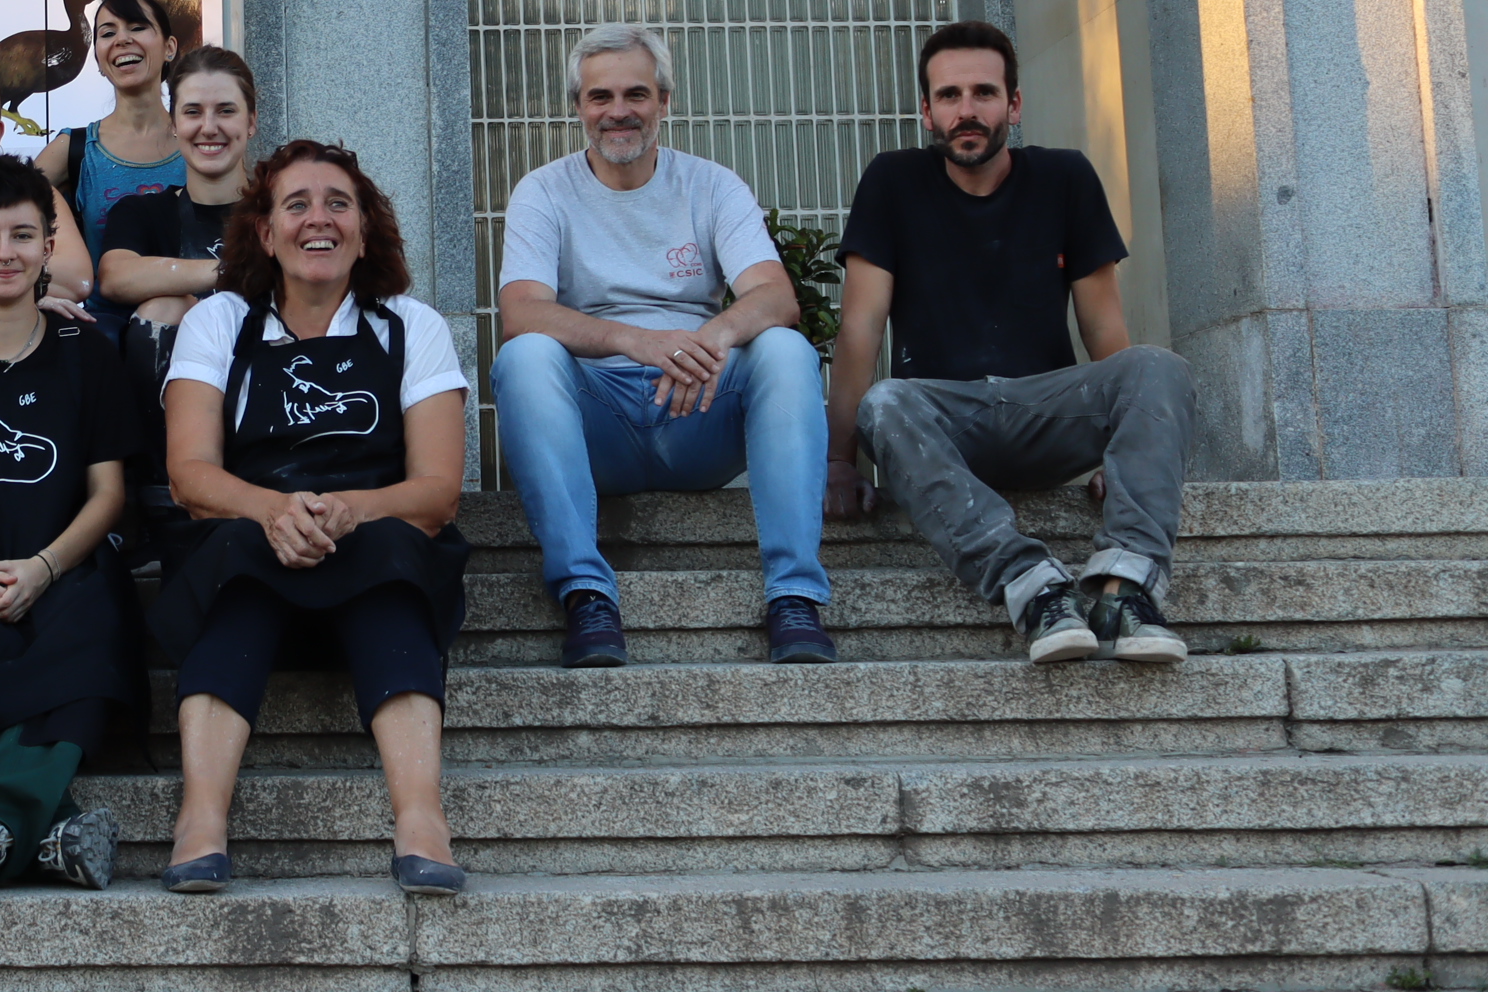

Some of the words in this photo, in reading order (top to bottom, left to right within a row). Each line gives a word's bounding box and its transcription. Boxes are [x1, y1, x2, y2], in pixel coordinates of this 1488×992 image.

[676, 268, 704, 278] CSIC
[336, 359, 354, 374] GBE
[19, 392, 37, 406] GBE
